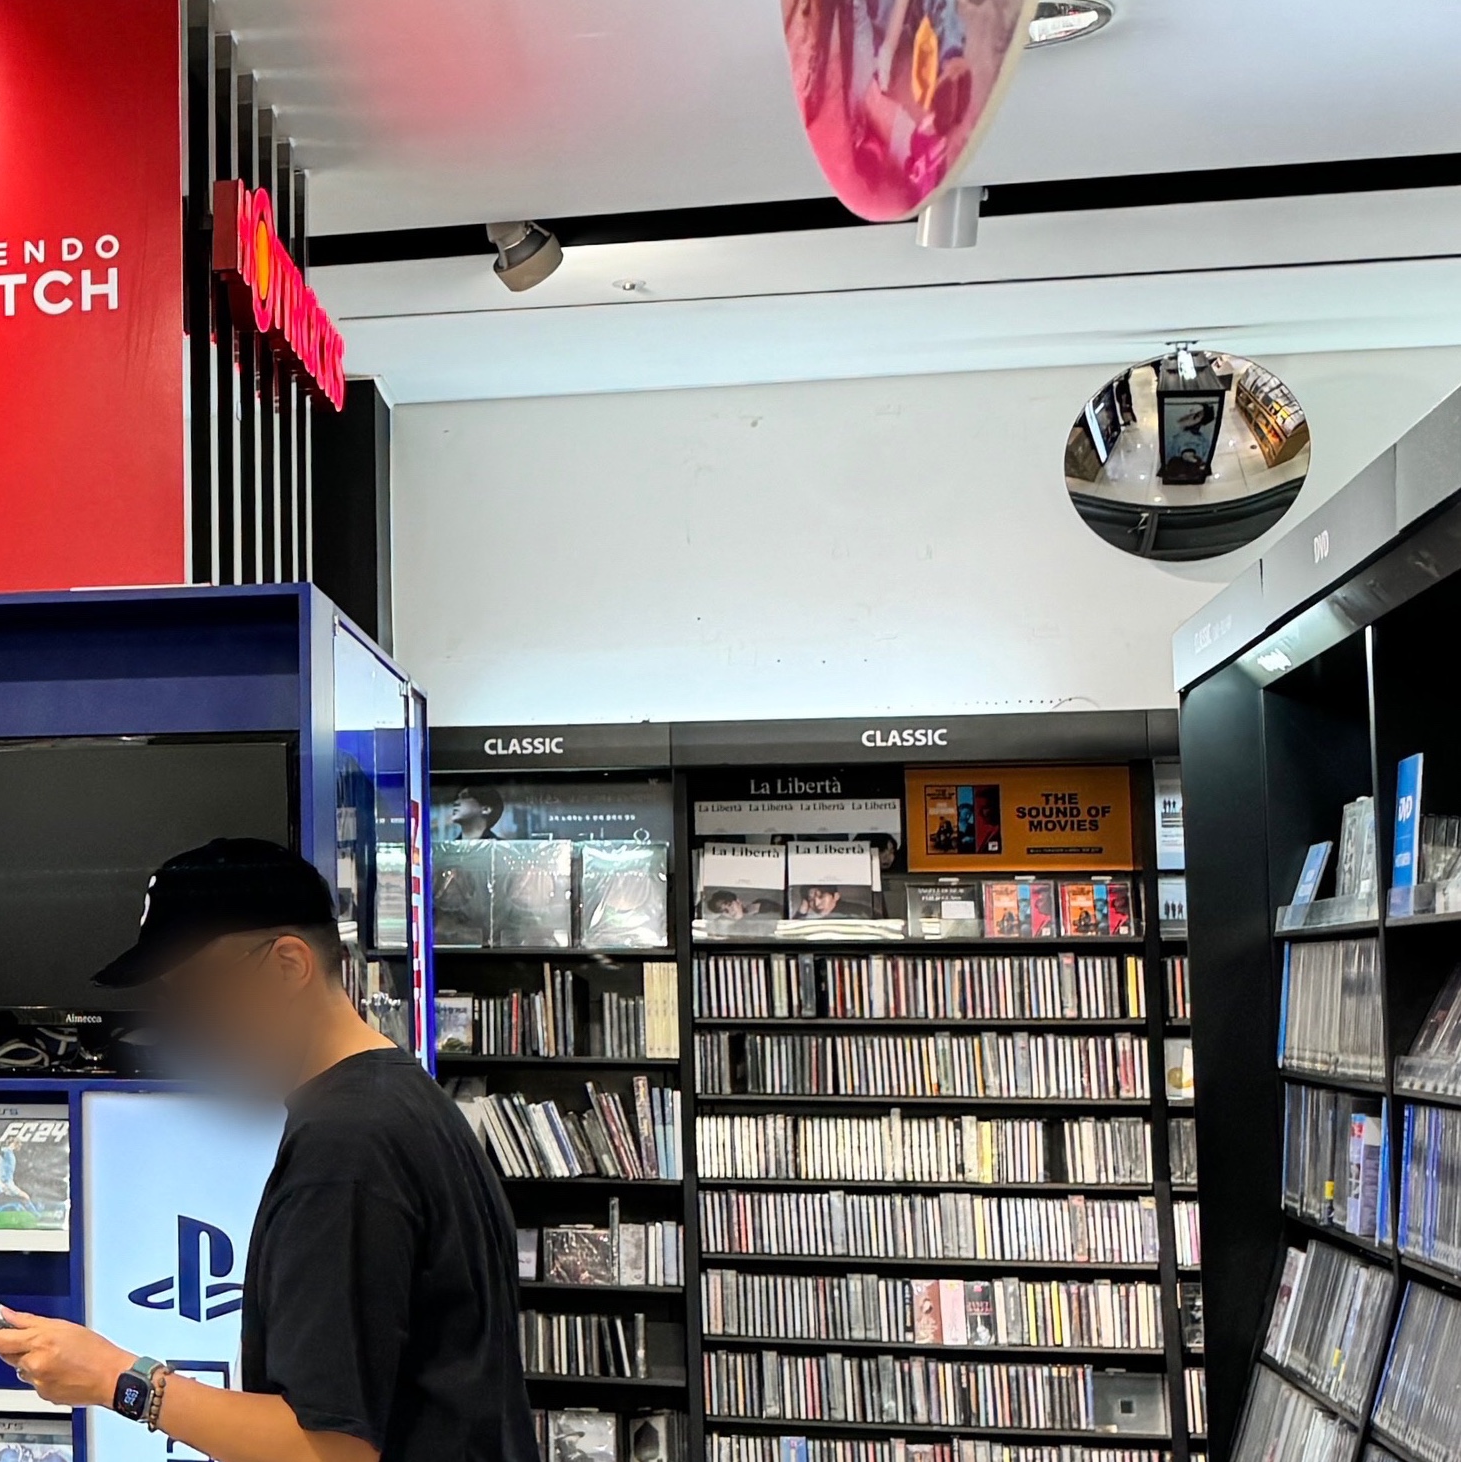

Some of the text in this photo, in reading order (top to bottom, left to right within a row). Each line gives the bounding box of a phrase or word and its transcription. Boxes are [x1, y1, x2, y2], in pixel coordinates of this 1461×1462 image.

[860, 728, 949, 748] CLASSIC
[483, 736, 564, 756] CLASSIC
[750, 776, 842, 795] La Libertà
[1041, 793, 1079, 806] THE
[698, 804, 708, 812] La
[749, 804, 759, 812] La
[800, 803, 810, 811] La
[852, 802, 862, 810] La
[865, 801, 896, 810] Libertà
[1015, 805, 1111, 819] SOUND OF
[1028, 819, 1100, 832] MOVIES
[712, 846, 780, 858] La Libertà
[795, 844, 864, 855] La Libertà
